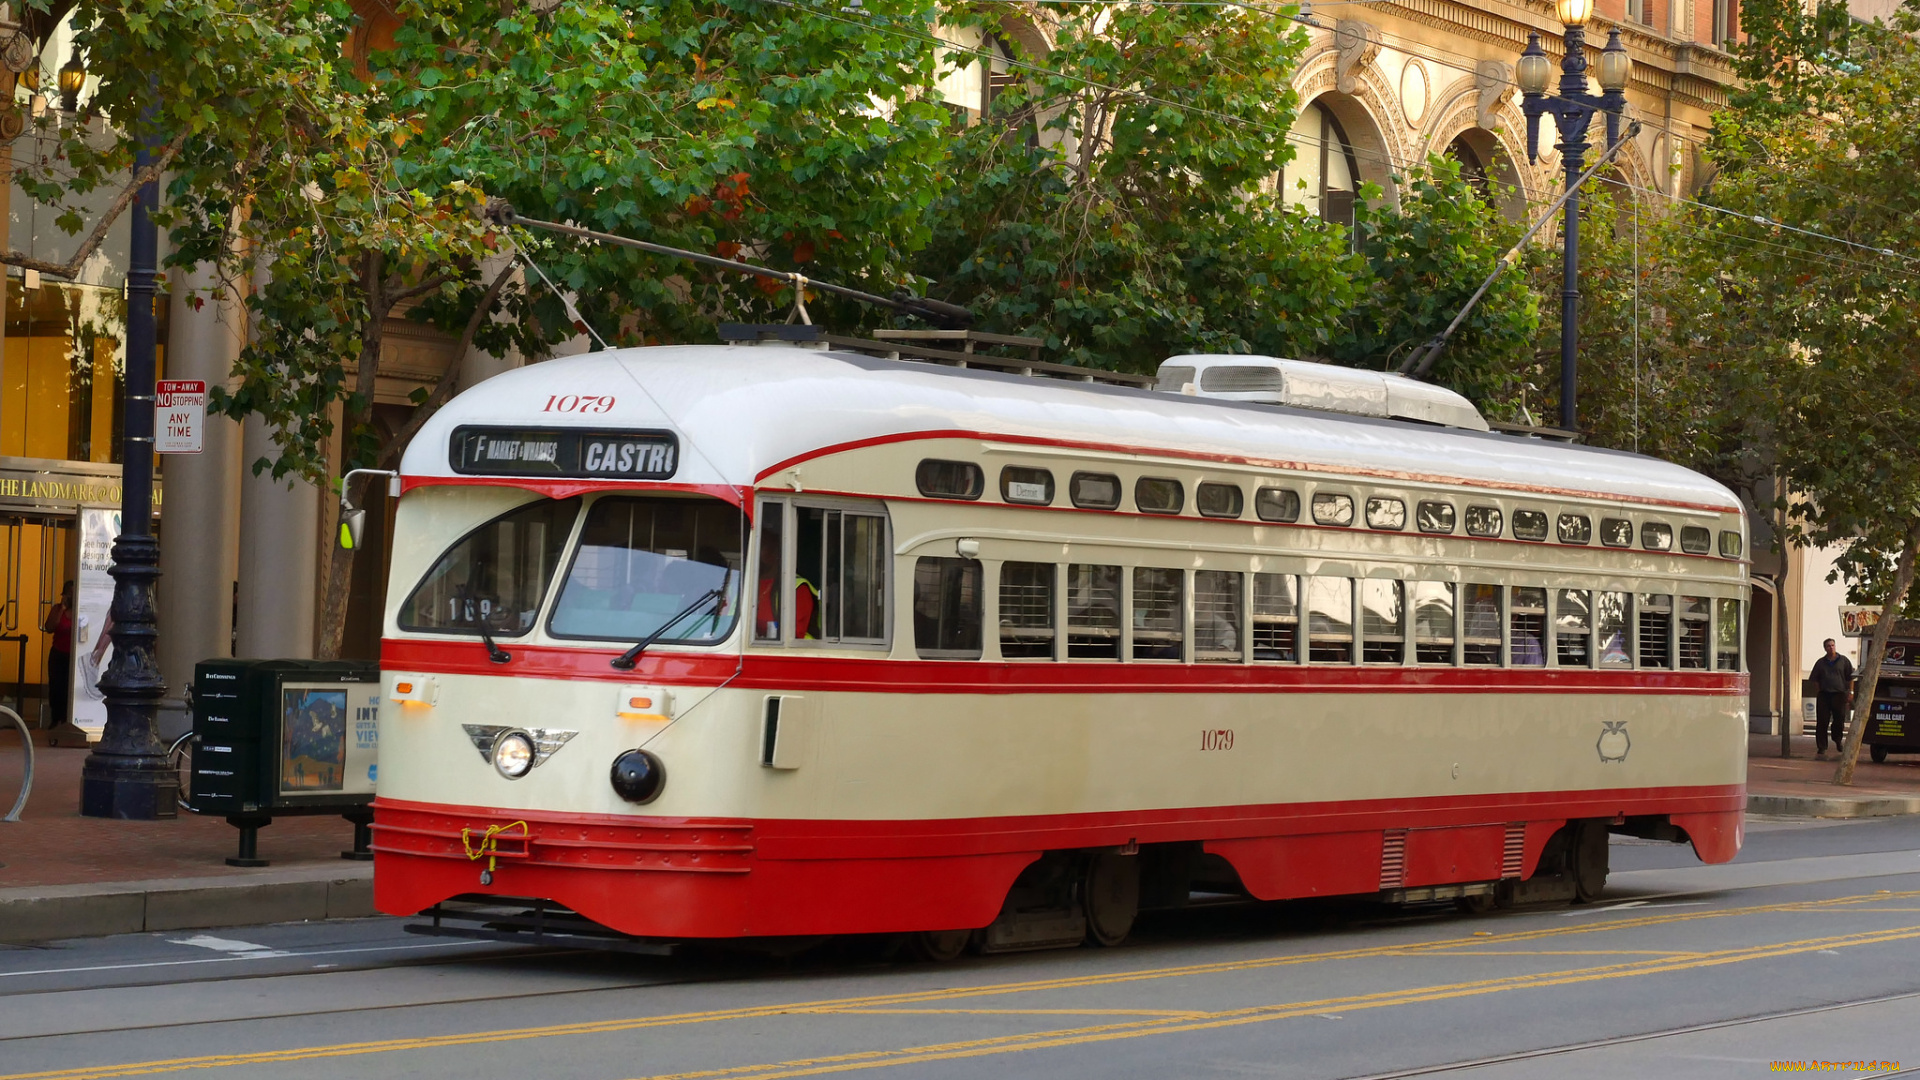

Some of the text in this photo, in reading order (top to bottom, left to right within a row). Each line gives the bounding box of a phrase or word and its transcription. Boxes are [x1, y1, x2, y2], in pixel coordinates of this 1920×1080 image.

[164, 383, 198, 391] TOW-AWAY
[157, 393, 203, 406] NO STOPPING
[540, 395, 616, 413] 1079
[169, 413, 190, 424] ANY
[167, 426, 191, 437] TIME
[474, 435, 487, 462] F
[487, 440, 520, 459] MARKET
[0, 478, 19, 496] HE
[22, 479, 96, 502] LANDMARK
[81, 562, 93, 571] the
[1200, 729, 1234, 751] 1079
